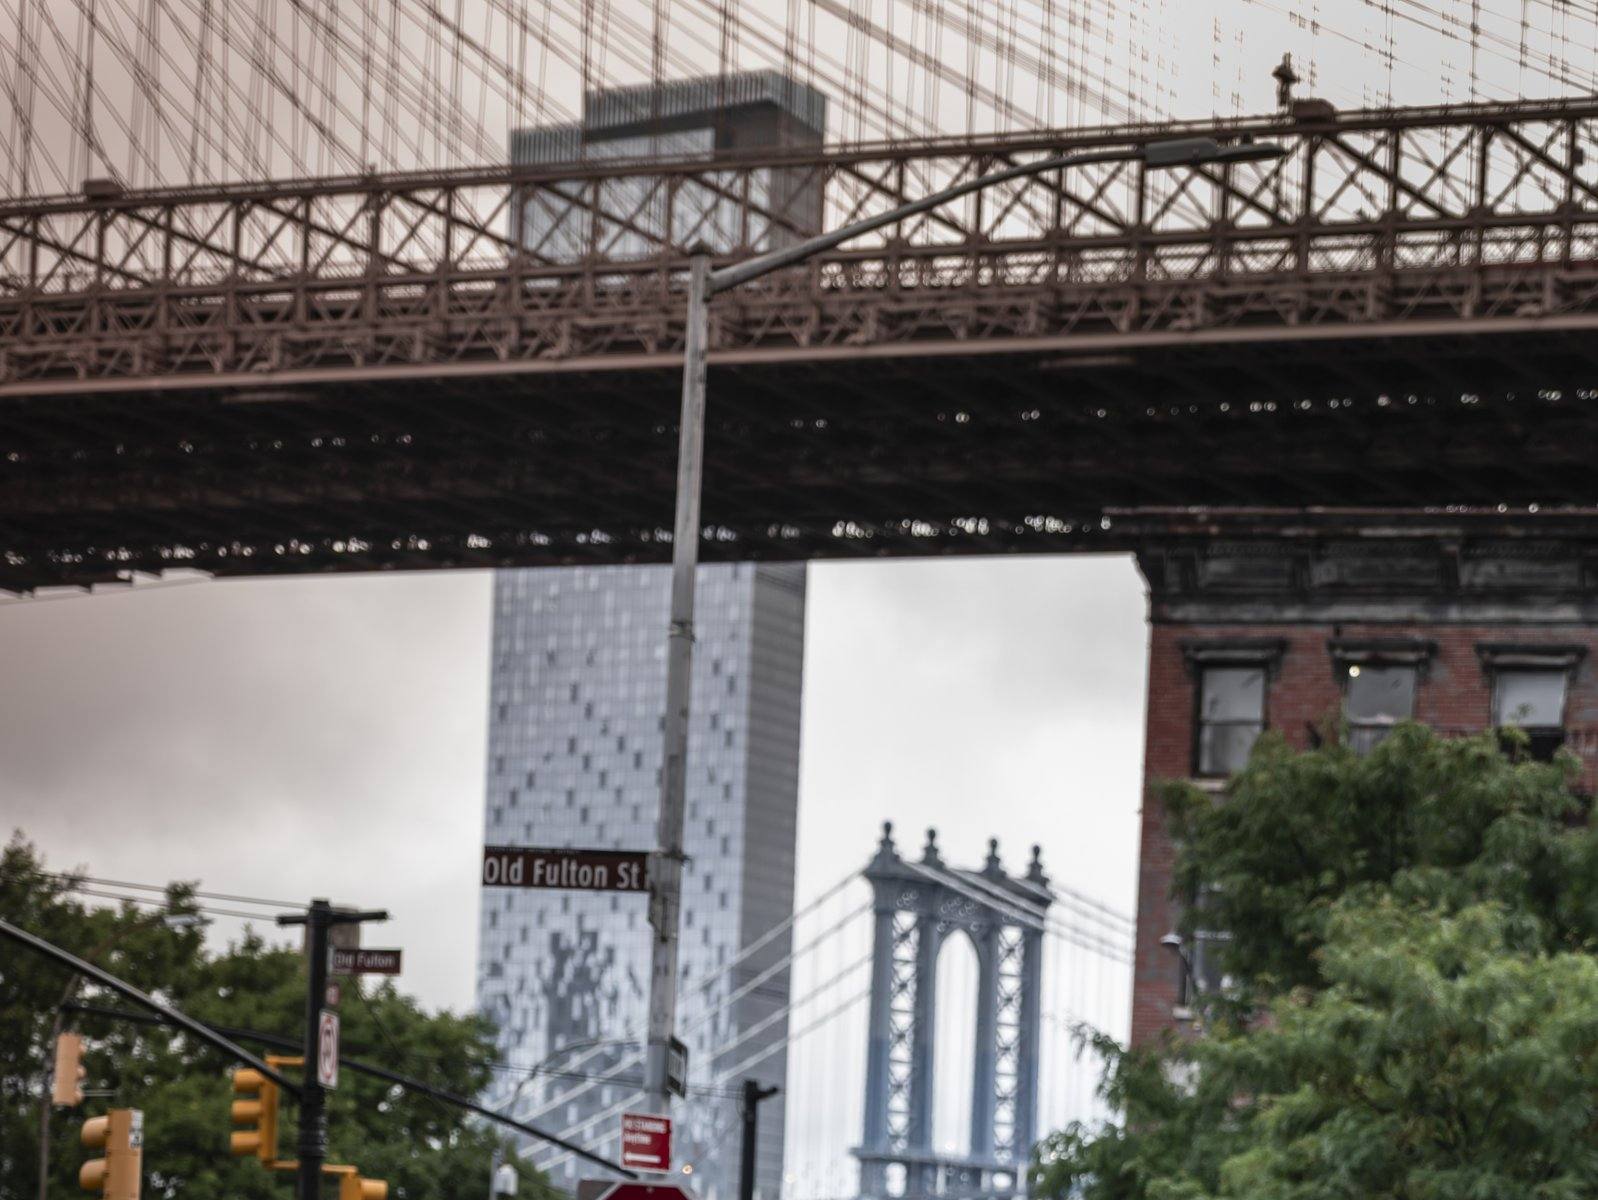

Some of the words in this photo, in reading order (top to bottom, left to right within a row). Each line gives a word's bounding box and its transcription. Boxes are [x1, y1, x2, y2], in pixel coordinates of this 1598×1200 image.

[484, 856, 523, 884] Old
[533, 857, 608, 887] Fulton
[616, 862, 640, 888] St
